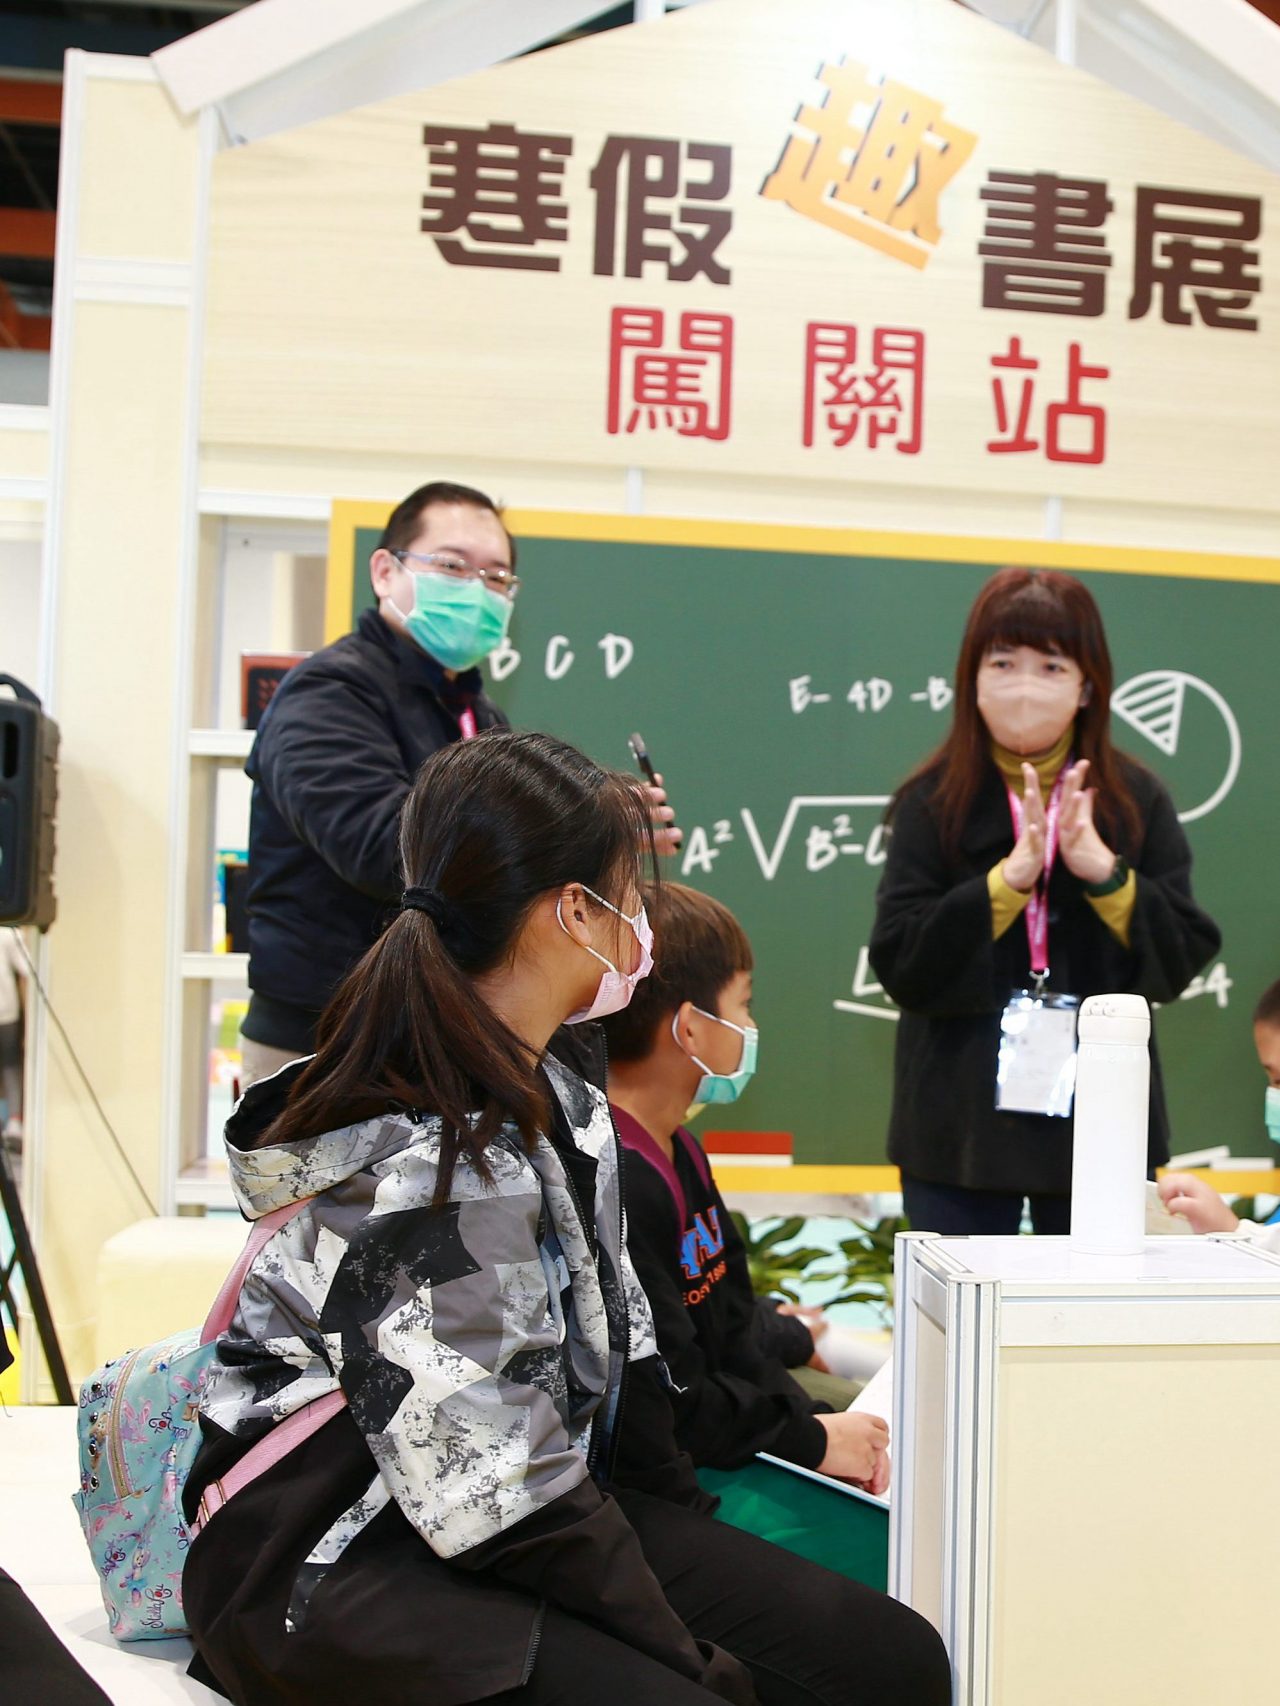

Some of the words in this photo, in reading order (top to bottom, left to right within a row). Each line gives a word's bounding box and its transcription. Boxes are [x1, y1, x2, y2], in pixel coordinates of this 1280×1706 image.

[420, 54, 1263, 332] 寒假趣書展
[606, 305, 1110, 466] 闖關站
